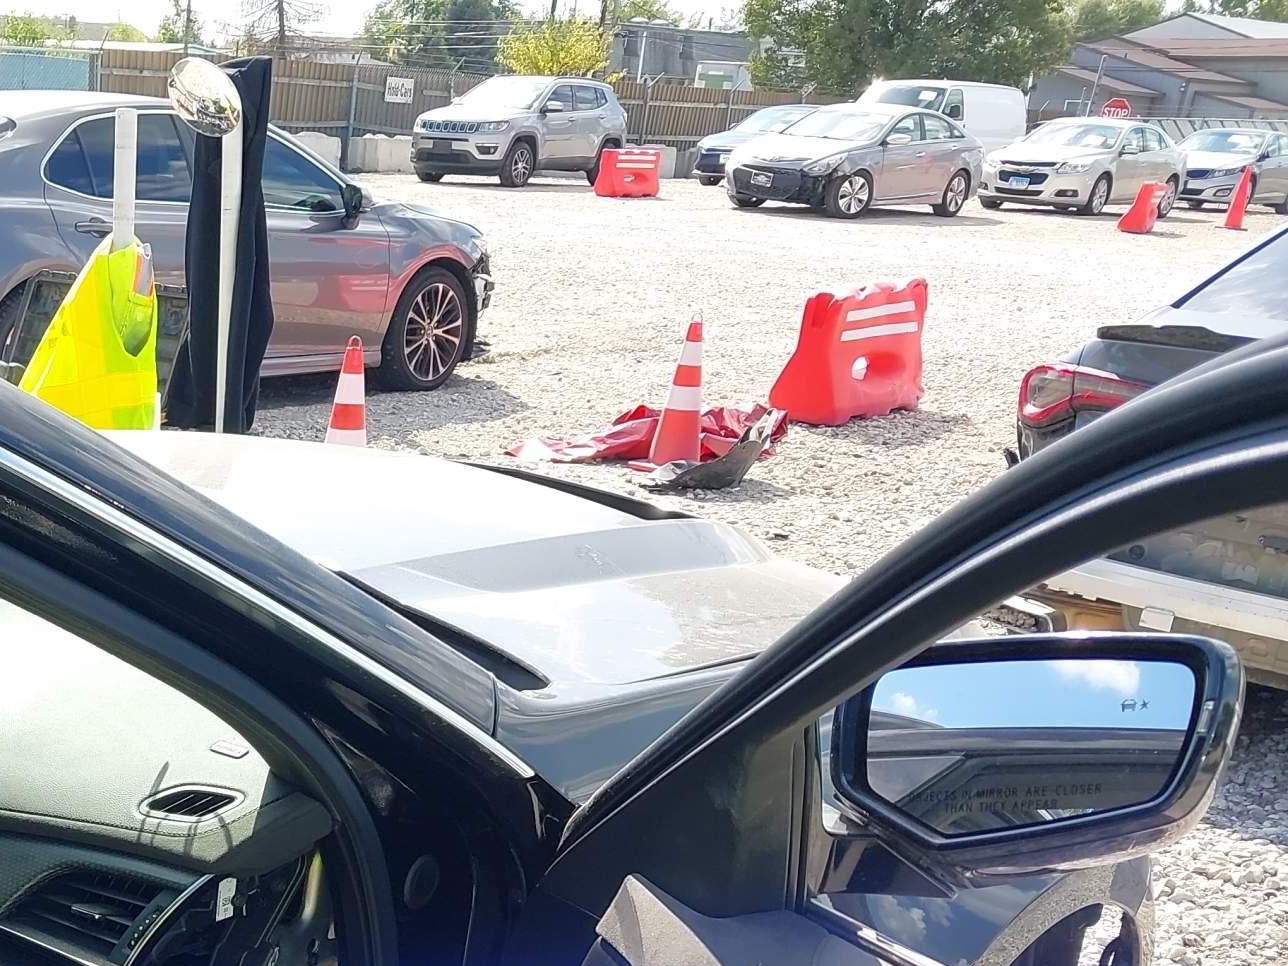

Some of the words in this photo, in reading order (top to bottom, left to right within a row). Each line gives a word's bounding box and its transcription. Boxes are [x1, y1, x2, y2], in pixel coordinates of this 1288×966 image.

[1104, 106, 1128, 119] STOP
[976, 786, 1018, 799] MIRROR
[1026, 785, 1048, 797] ARE
[1056, 783, 1103, 796] CLOSER
[945, 803, 973, 815] THAN
[979, 801, 1006, 813] THEY
[1013, 798, 1057, 812] APPEAR
